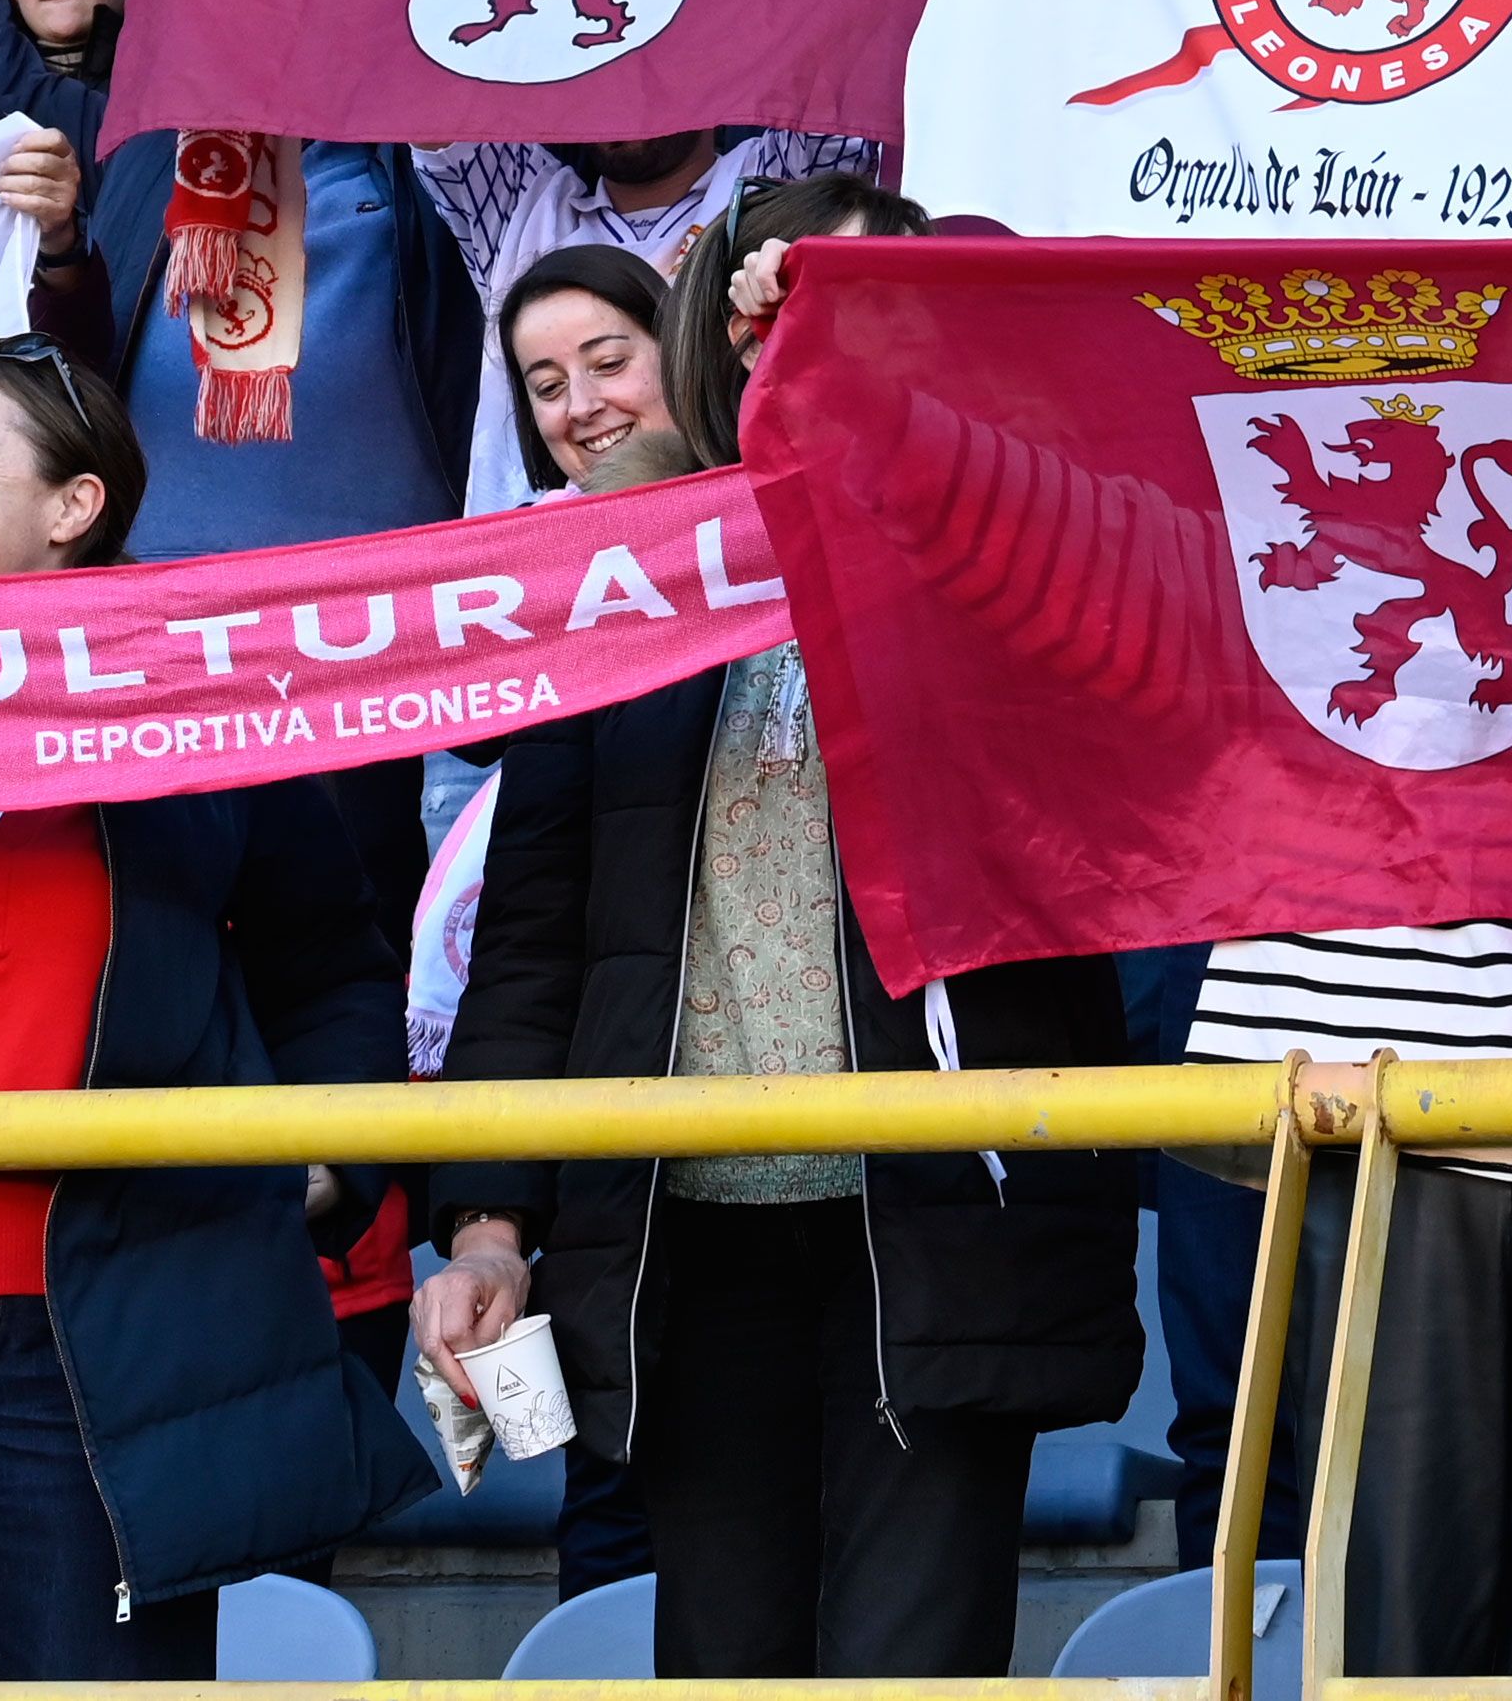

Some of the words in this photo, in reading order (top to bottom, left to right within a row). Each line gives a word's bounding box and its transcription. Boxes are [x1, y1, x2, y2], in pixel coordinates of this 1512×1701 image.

[1129, 136, 1260, 225] Orgullo
[1265, 145, 1301, 216] de
[1308, 146, 1405, 219] León
[33, 705, 316, 766] DEPORTIVA
[333, 671, 562, 741] LEONESA
[264, 669, 294, 699] Y
